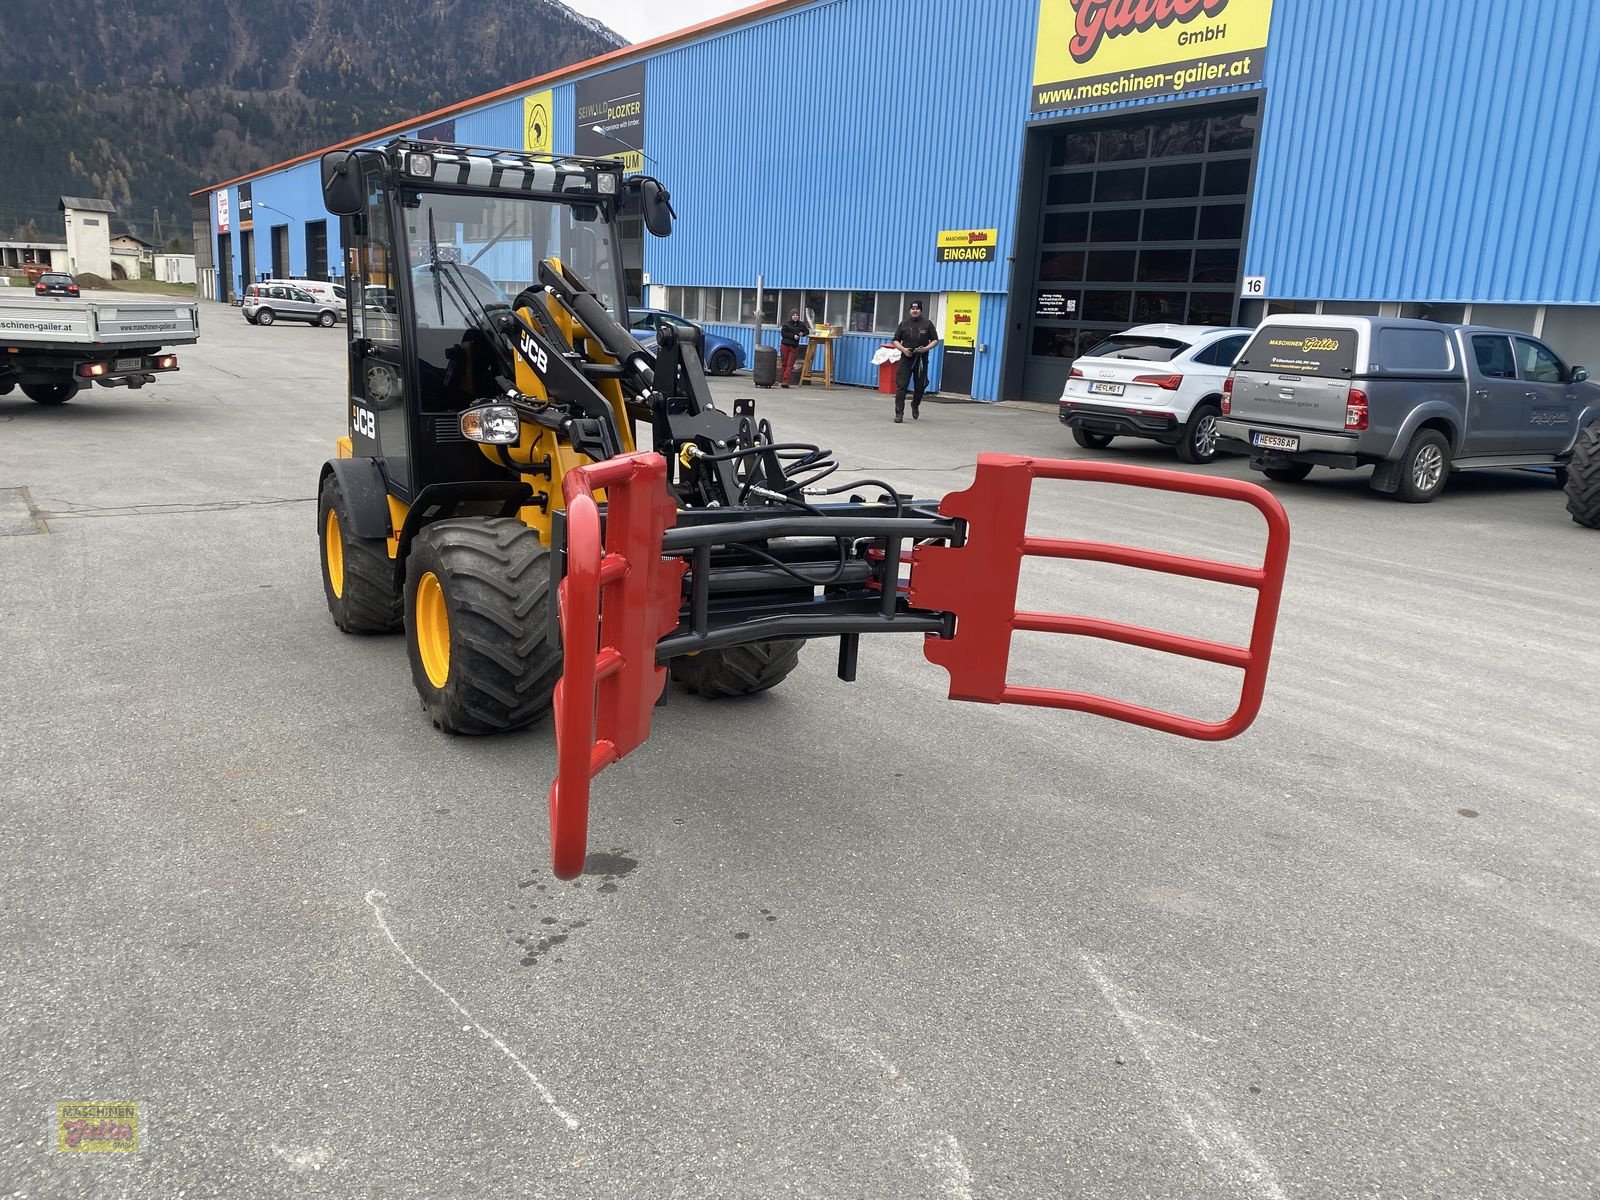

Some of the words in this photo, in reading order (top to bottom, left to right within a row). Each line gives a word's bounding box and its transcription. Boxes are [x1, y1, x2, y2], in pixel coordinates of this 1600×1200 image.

[1069, 0, 1229, 64] Gai
[1178, 24, 1227, 46] GmbH
[1038, 56, 1251, 105] www.maschinen-gailer.at
[607, 101, 640, 120] PLOZKER
[943, 248, 987, 260] EINGANG
[1247, 279, 1262, 293] 16
[0, 321, 73, 331] schinen-gailer.at
[519, 329, 548, 374] JCB
[1269, 339, 1303, 347] MASCHINEN
[352, 405, 376, 440] JCB
